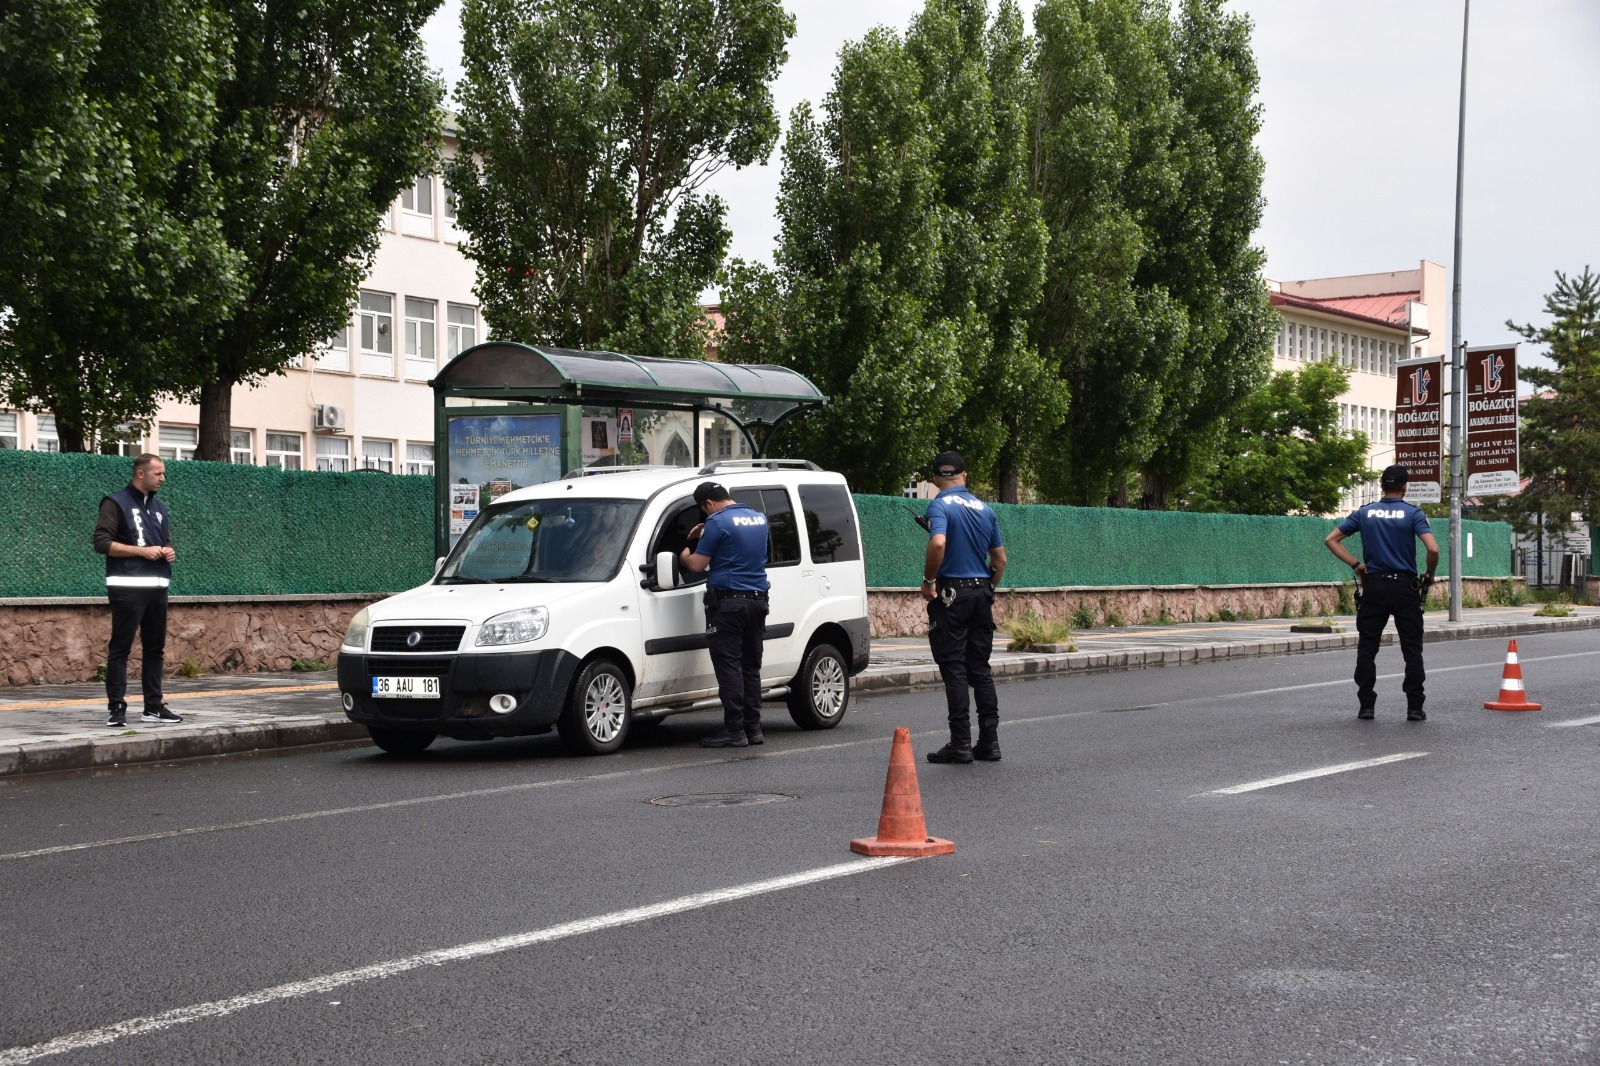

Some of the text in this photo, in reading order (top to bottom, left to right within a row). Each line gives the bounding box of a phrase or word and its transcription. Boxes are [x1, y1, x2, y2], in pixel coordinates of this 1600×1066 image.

[1469, 395, 1515, 412] BOĞAZİÇİ
[1397, 408, 1439, 424] BOĞAZİÇİ
[1469, 412, 1515, 426] ANADOLU LİSESİ
[1397, 425, 1439, 437] ANADOLU LİSESİ
[465, 435, 499, 445] TÜRKİYE
[456, 447, 499, 457] MEHMETÇİK
[502, 447, 521, 456] TÜRK
[1470, 447, 1516, 457] SINIFLAR İÇİN
[1475, 458, 1488, 466] DİL
[942, 495, 984, 511] POLIS
[1367, 509, 1405, 519] POLIS
[732, 515, 766, 526] POLIS
[131, 508, 146, 547] POLIS
[378, 678, 390, 692] 36
[396, 678, 413, 692] AAU
[422, 678, 438, 693] 181
